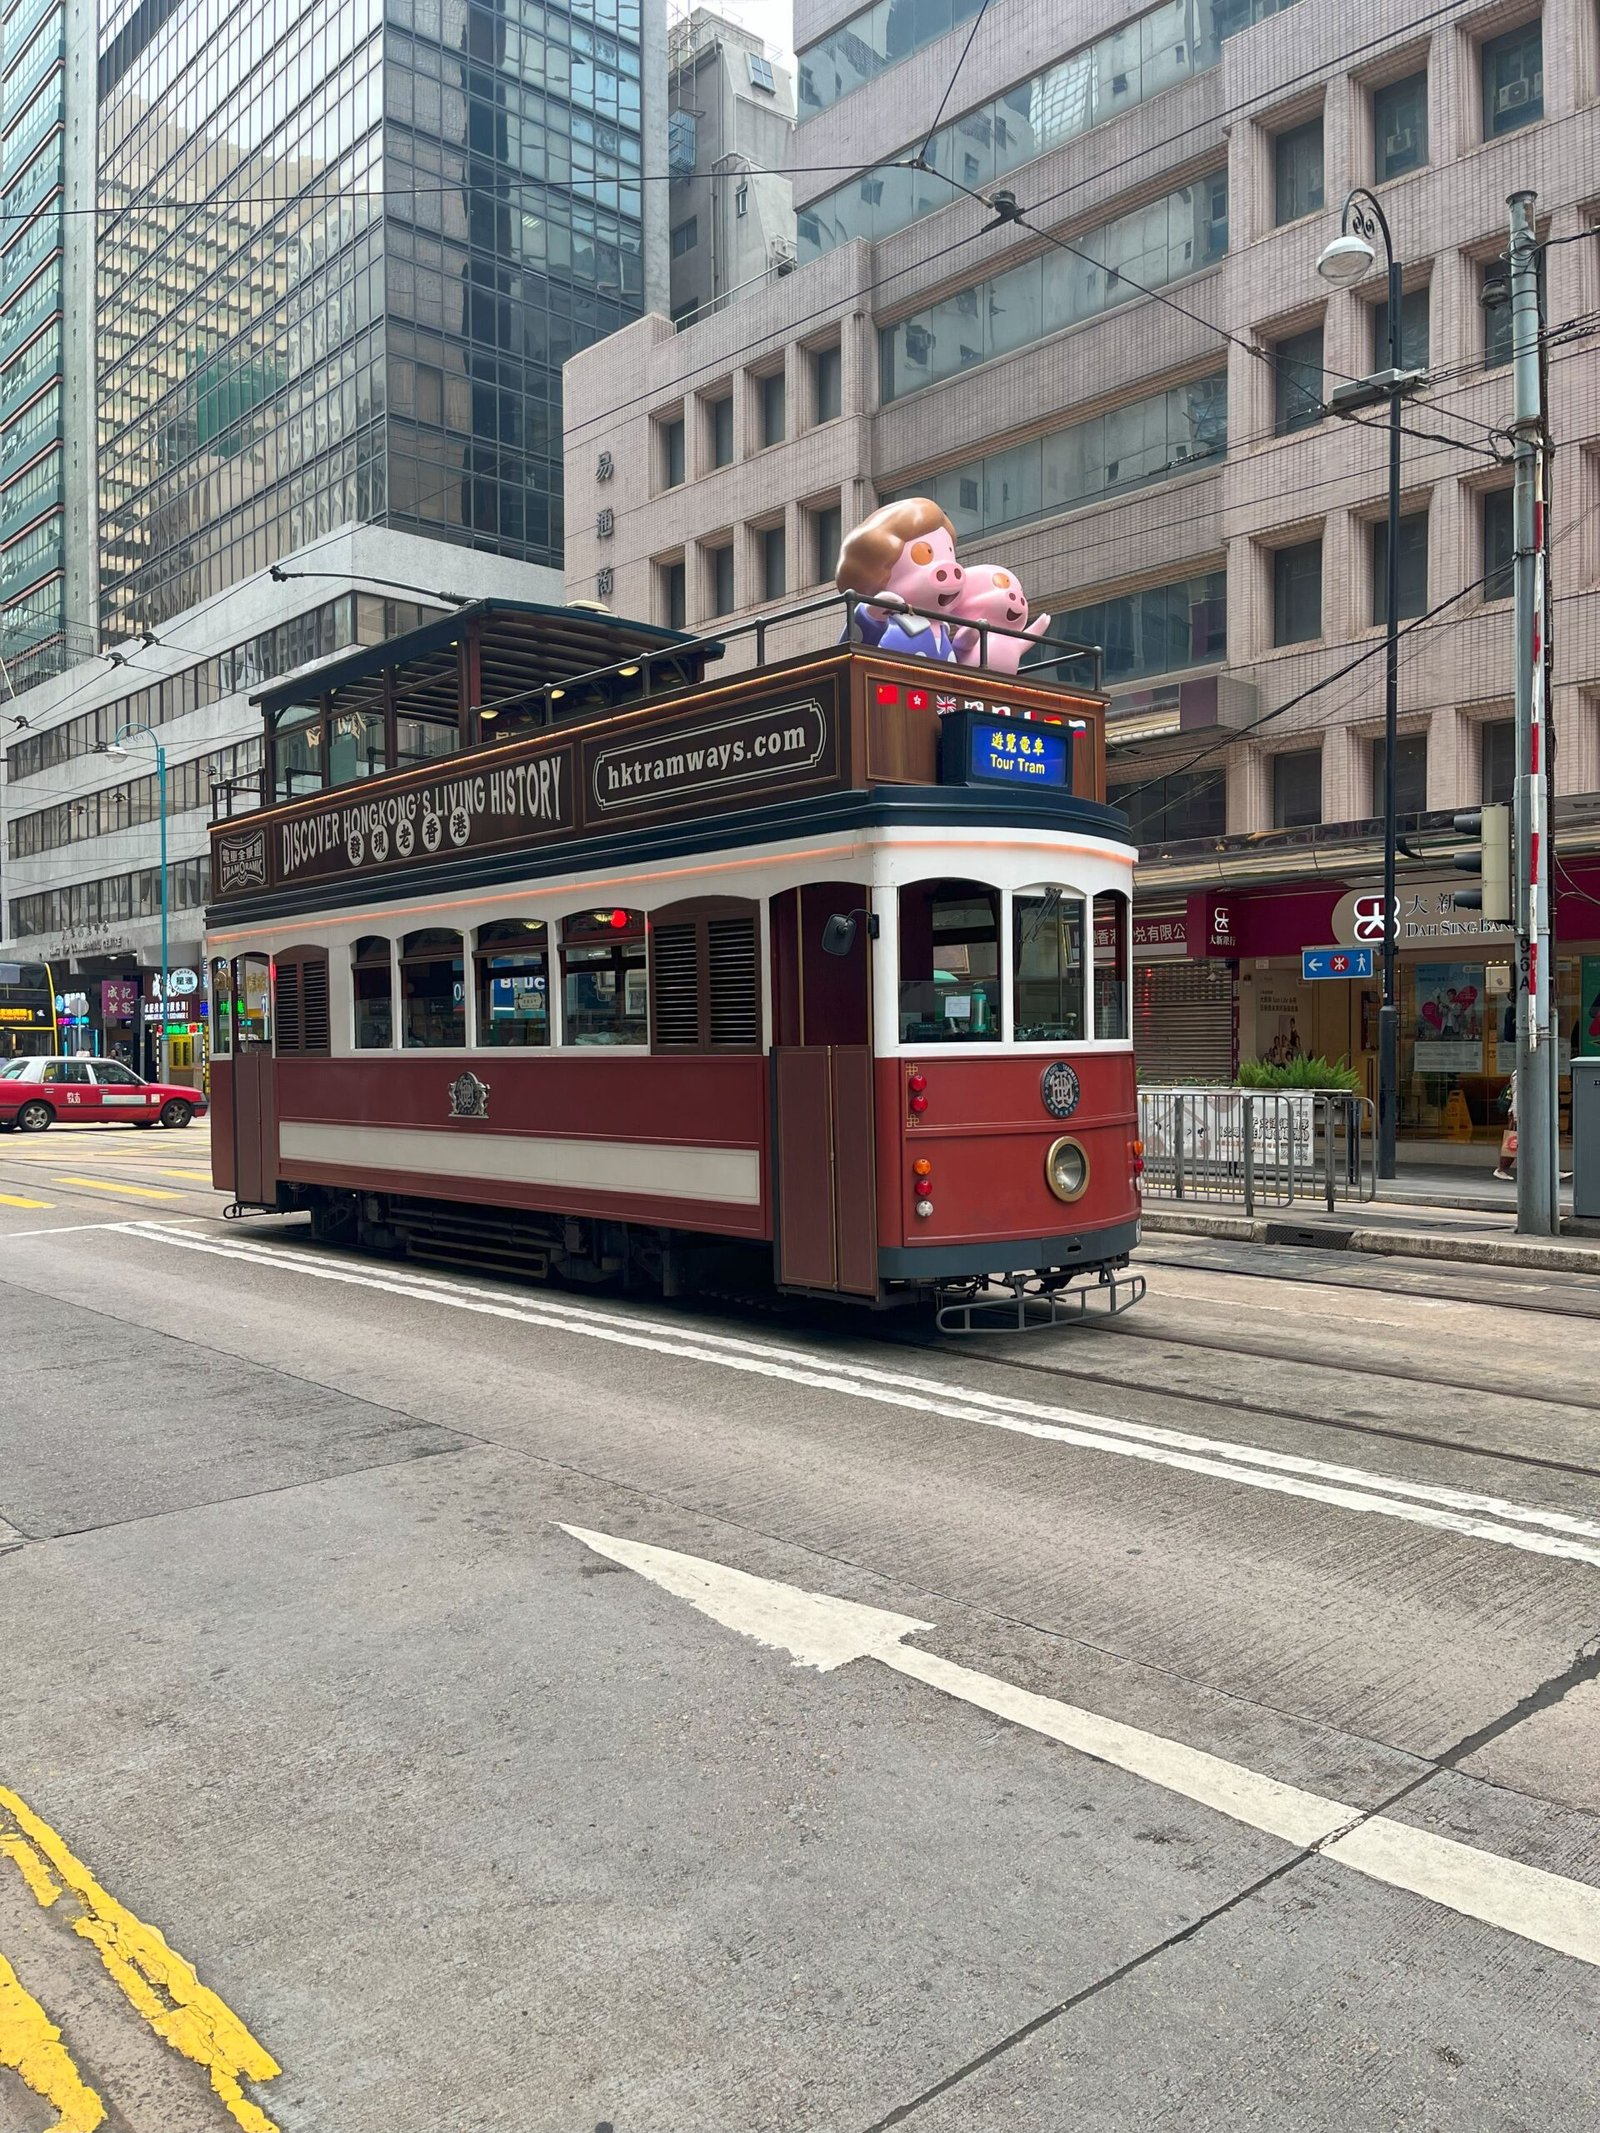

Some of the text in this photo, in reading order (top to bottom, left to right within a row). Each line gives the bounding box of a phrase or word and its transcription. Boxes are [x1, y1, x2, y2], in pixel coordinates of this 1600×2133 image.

[607, 726, 806, 790] hktramways.com
[990, 732, 1045, 756] 遊覽電車
[990, 753, 1046, 775] Tour Tram
[282, 813, 341, 876] DISCOVER
[435, 774, 486, 817] LIVING
[490, 756, 562, 821] HISTORY
[349, 808, 469, 864] 發現老香港
[1405, 917, 1515, 938] DAH SING BAN
